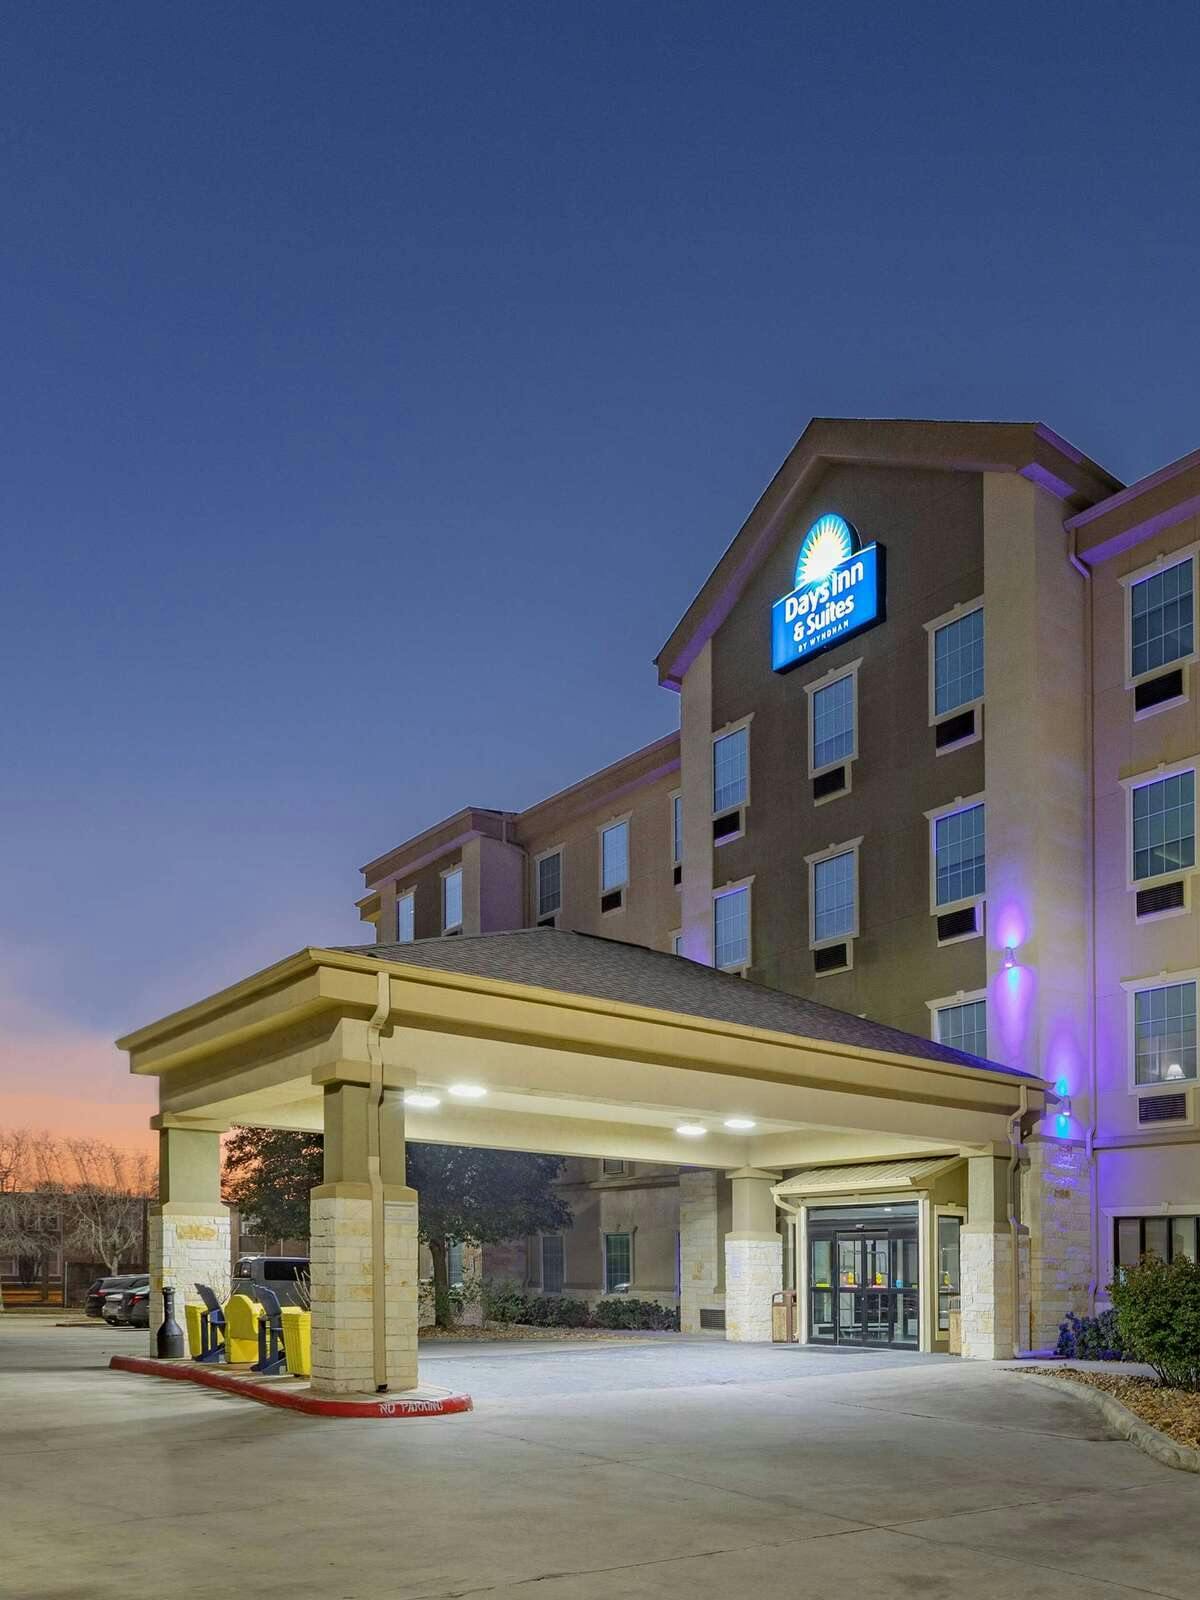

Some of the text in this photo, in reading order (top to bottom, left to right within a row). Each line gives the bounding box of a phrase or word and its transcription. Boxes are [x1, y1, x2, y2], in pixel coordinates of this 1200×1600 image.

[785, 561, 864, 623] Days Inn
[793, 594, 855, 642] & Suites
[809, 619, 849, 647] WYNDHAM
[379, 1400, 444, 1414] NO PARKING
